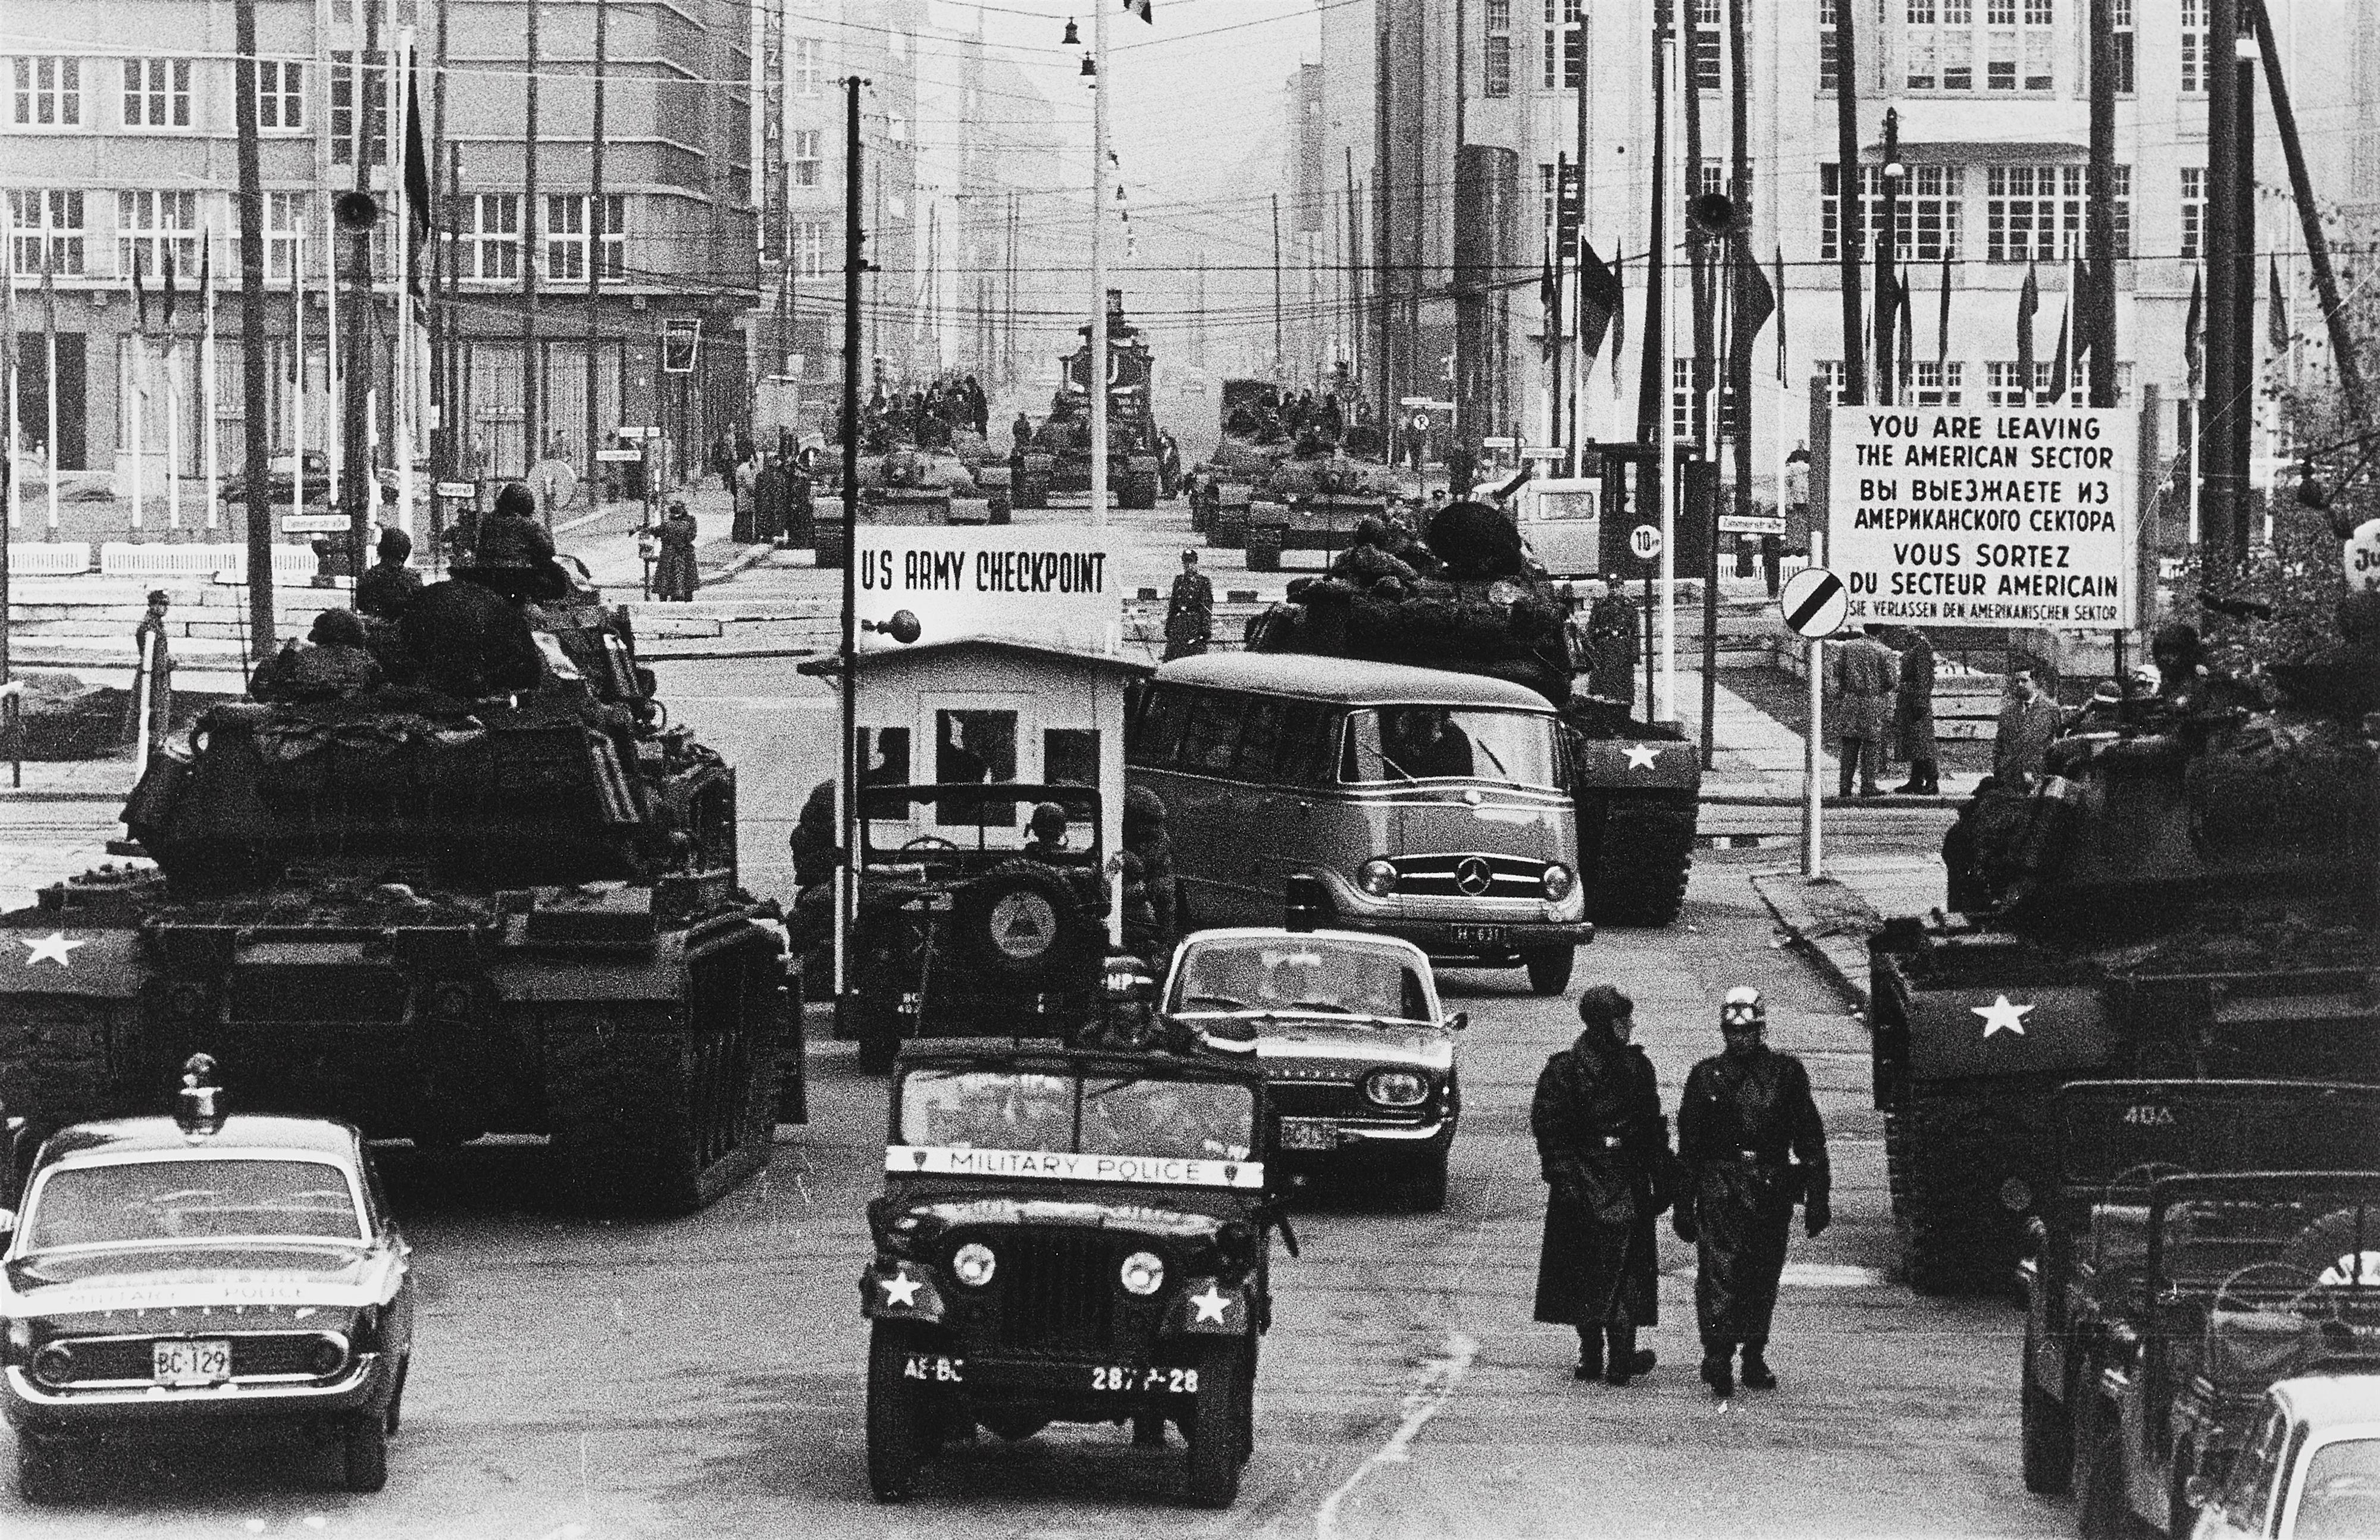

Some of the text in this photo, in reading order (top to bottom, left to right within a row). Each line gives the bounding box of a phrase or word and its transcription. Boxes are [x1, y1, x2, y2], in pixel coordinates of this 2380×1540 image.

[1869, 415, 2099, 440] YOU ARE LEAVING
[1856, 445, 2112, 468] THE AMERICAN SECTOR
[1861, 479, 2108, 504] ВЫ ВЫЕЗЖАЕТЕ ИЗ
[1855, 509, 2115, 531] АМЕРИКАНСКОГО СЕКТОРА
[1636, 531, 1651, 551] 10
[1894, 544, 2069, 567] VOUS SORTEZ
[863, 550, 1106, 592] US ARMY CHECKPOINT
[1850, 572, 2116, 597] DU SECTEUR AMERICAIN
[1850, 601, 2116, 620] SIE VERLASSEN DEN AMERIKANISCHEN SEKTOR
[1108, 974, 1135, 990] MP
[950, 1151, 1201, 1181] MILITARY POLICE
